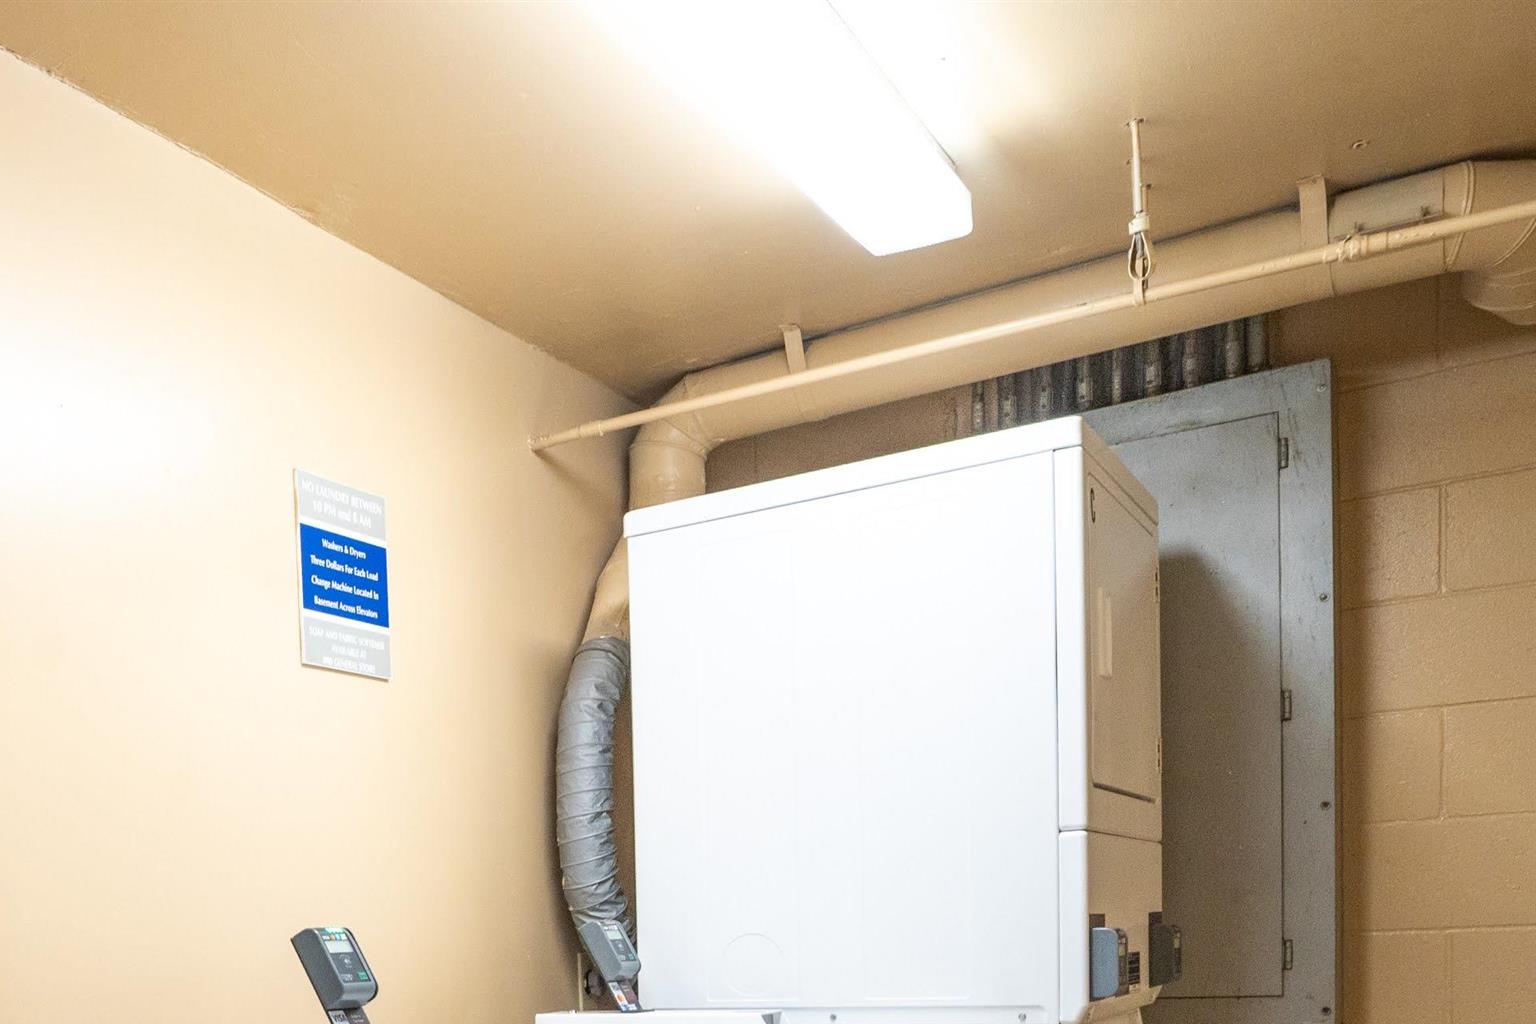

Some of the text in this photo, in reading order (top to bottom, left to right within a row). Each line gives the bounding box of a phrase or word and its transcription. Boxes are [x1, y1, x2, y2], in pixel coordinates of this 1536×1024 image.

[302, 480, 382, 515] NO LAUNDRY BETWEEN
[324, 501, 336, 517] PM
[321, 538, 366, 560] Washers & Dryers
[310, 554, 379, 581] Three Dollars For Each Load
[311, 575, 379, 600] Change Machine Located In
[313, 595, 378, 619] Basement Across Elevators
